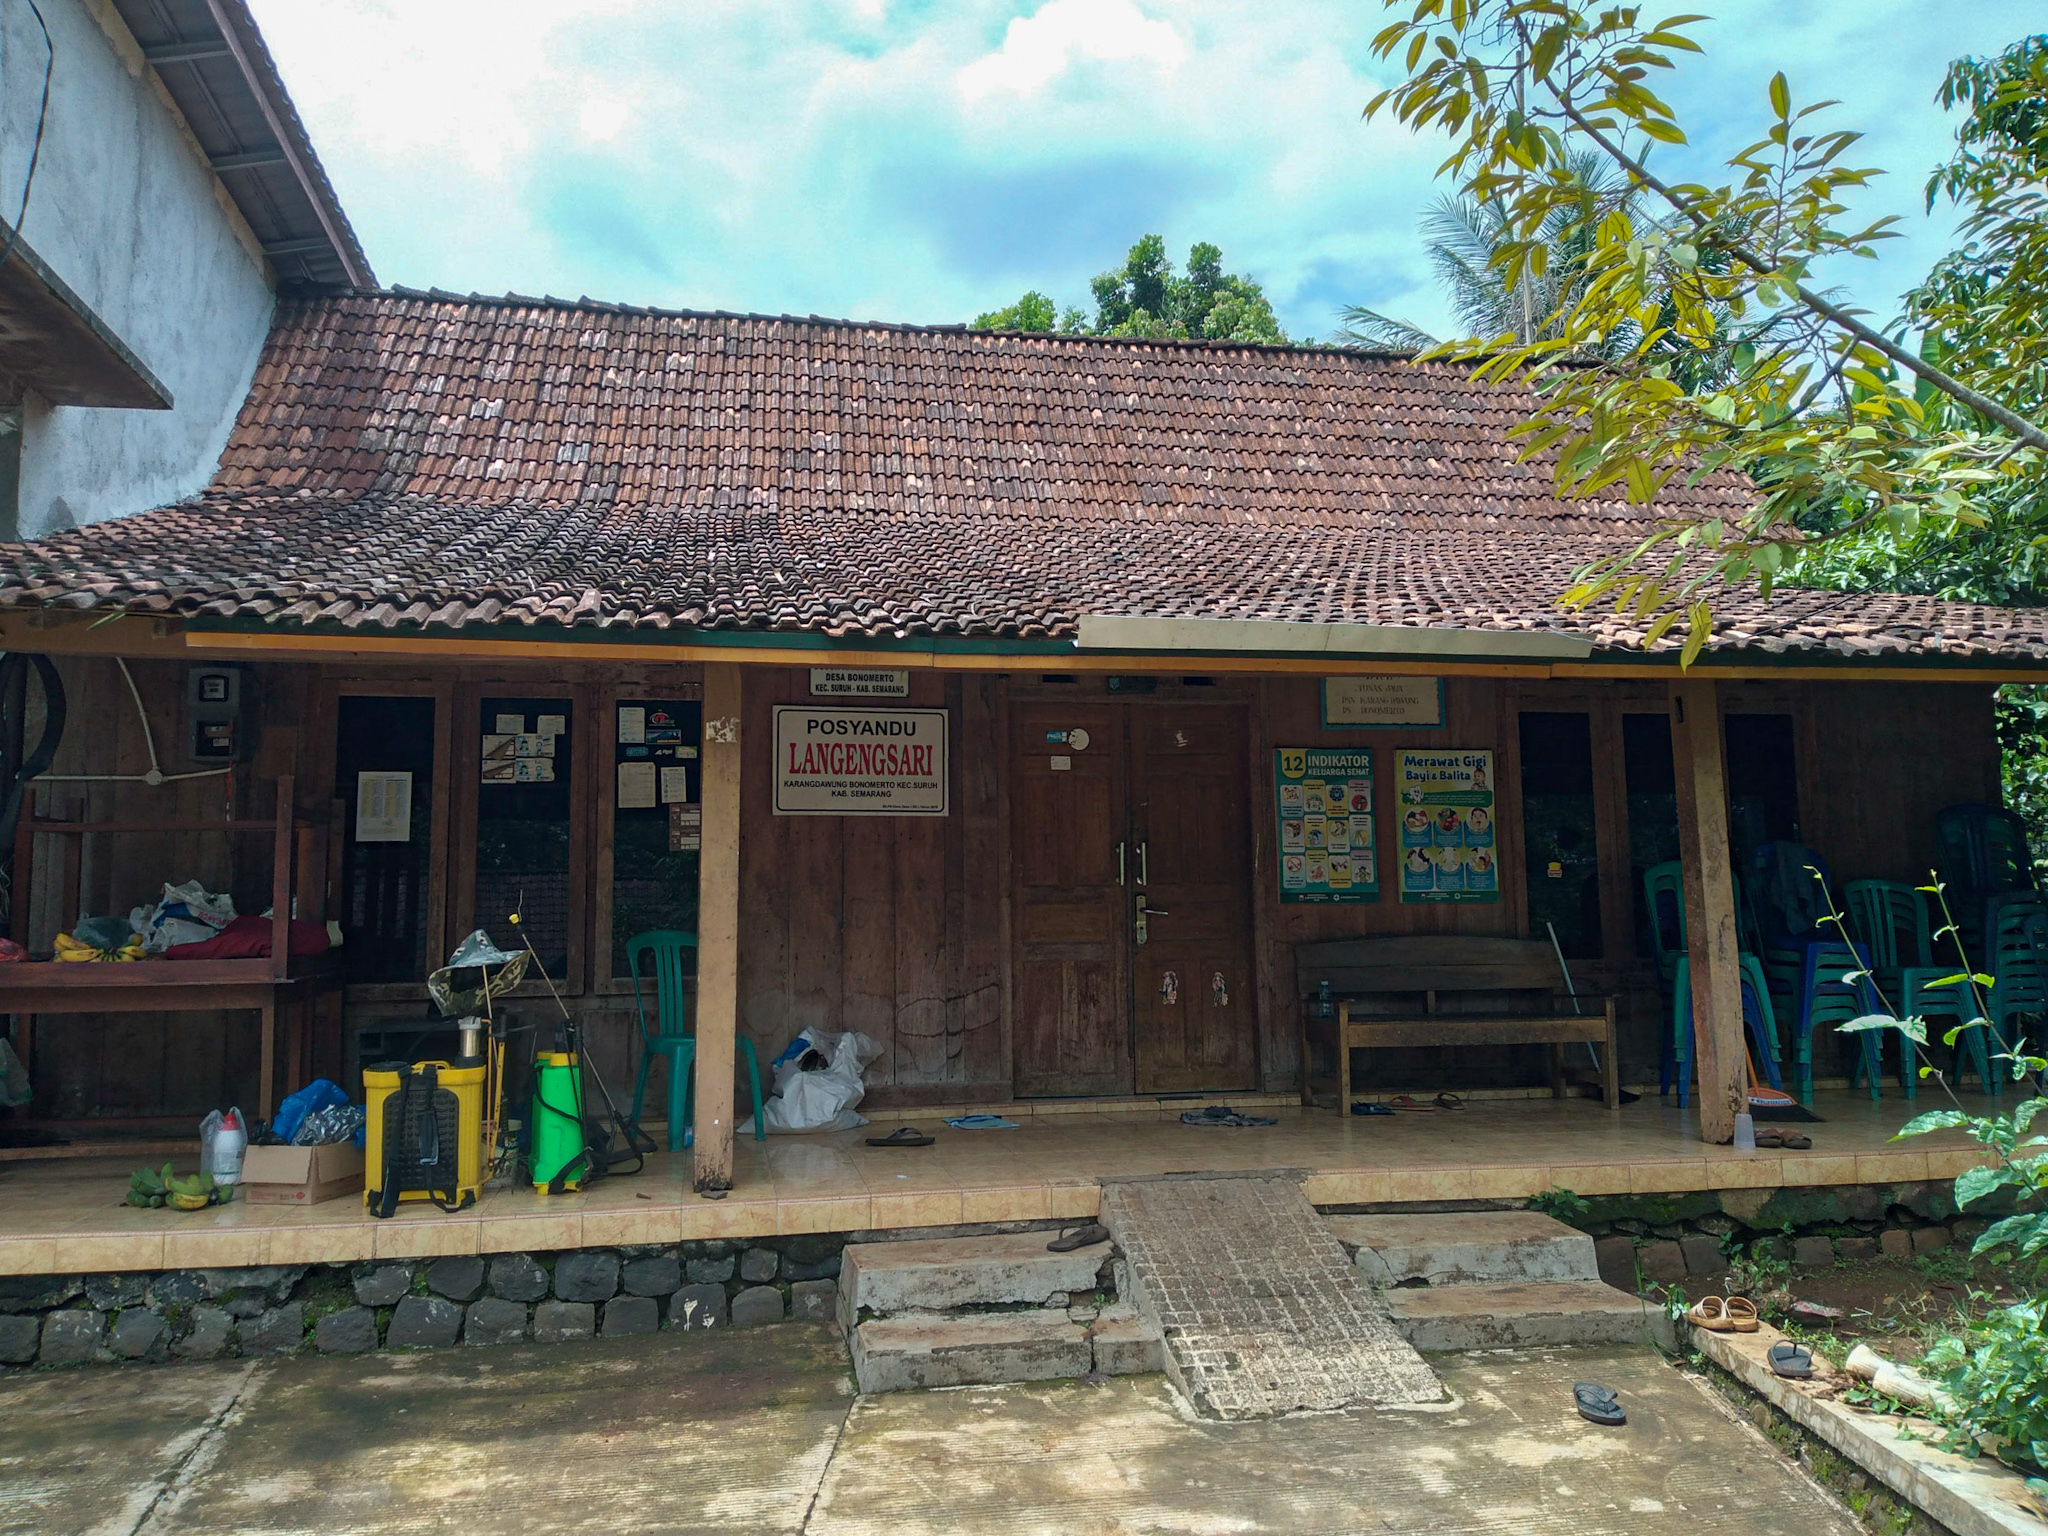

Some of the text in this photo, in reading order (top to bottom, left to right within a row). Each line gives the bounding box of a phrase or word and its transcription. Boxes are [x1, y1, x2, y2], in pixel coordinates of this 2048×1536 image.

[826, 673, 894, 682] DESA BONOMERTO
[816, 684, 829, 692] KEC.
[831, 684, 851, 692] SURUH
[857, 685, 871, 693] KAB.
[872, 685, 904, 693] SEMARANG
[807, 719, 916, 736] POSYANDU
[789, 742, 933, 776] LANGENGSARI
[1283, 756, 1303, 772] 12
[1307, 755, 1369, 767] INDIKATOR
[1404, 755, 1487, 769] Merawat Gigi
[1307, 768, 1370, 776] KELUARGA SEHAT
[1406, 770, 1430, 783] Bayi
[1439, 770, 1471, 781] Balita
[783, 780, 848, 788] KARANGDAWUNG
[849, 780, 895, 788] BONOMERTO
[850, 790, 892, 798] SEMARANG
